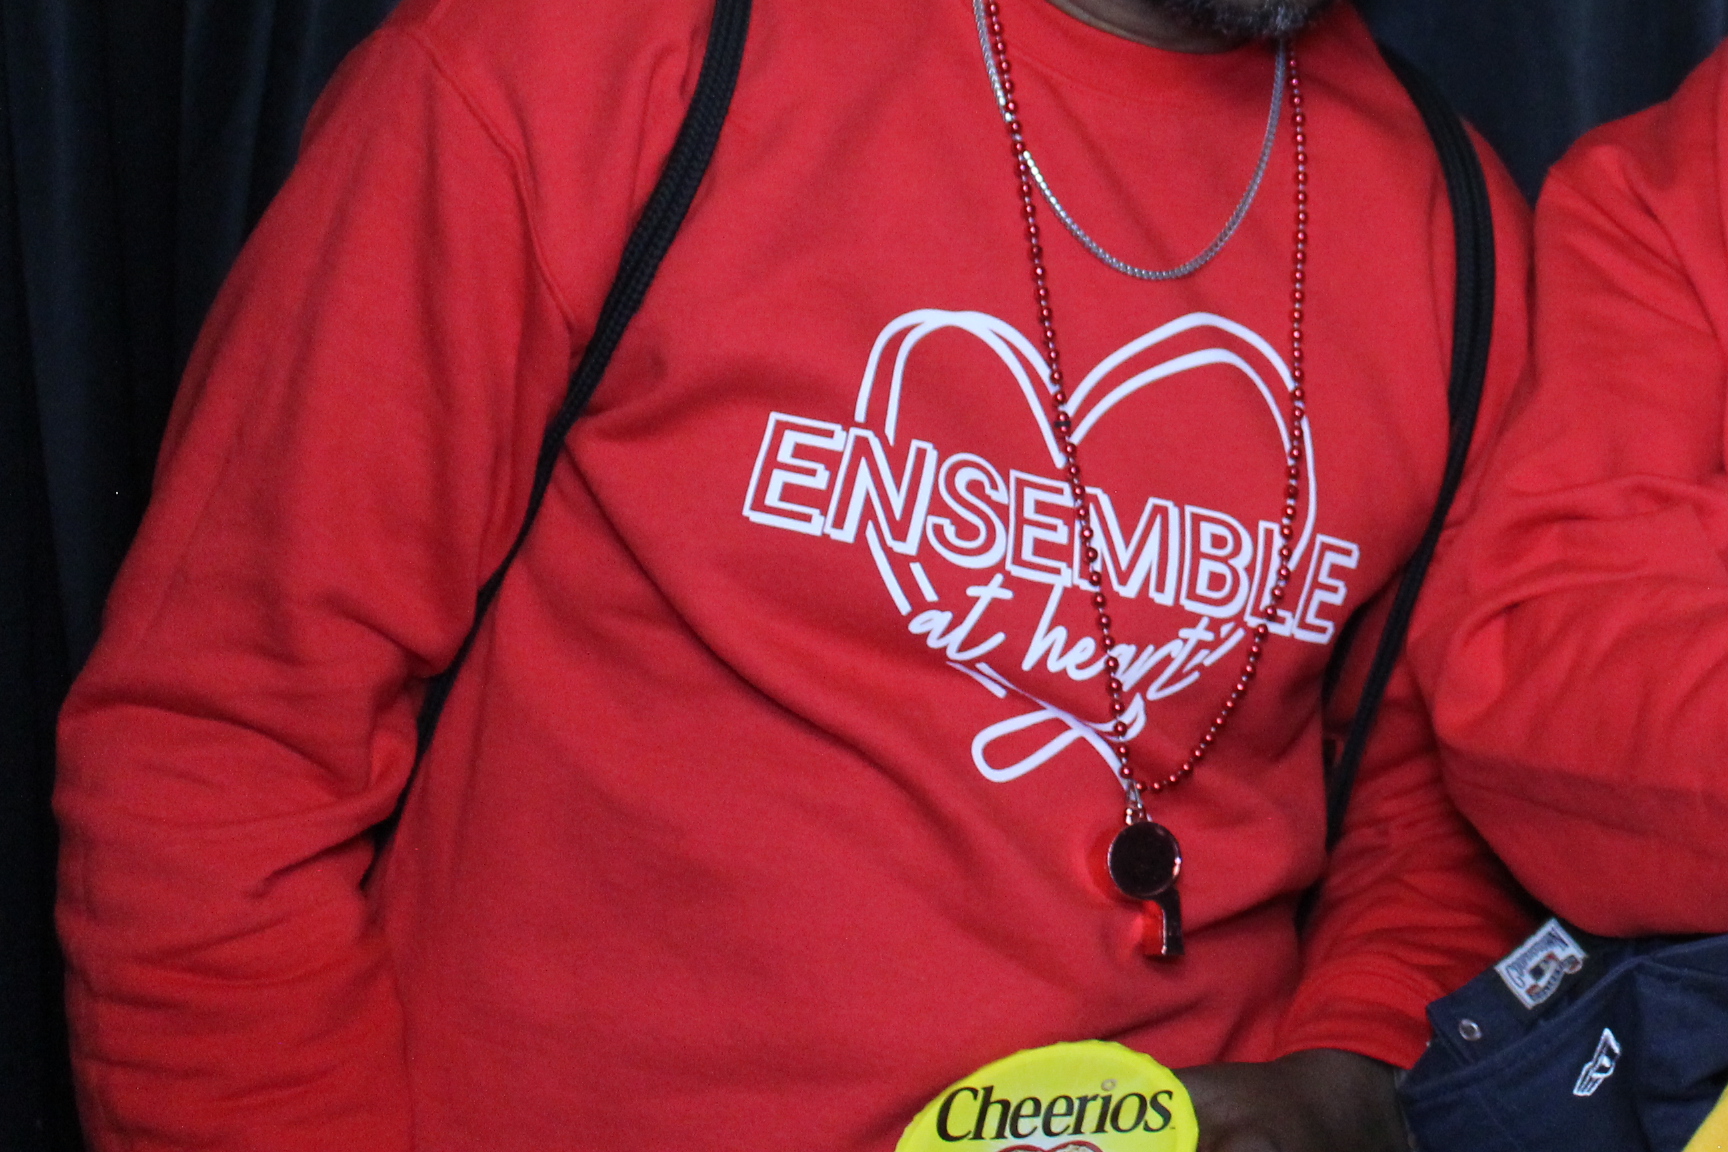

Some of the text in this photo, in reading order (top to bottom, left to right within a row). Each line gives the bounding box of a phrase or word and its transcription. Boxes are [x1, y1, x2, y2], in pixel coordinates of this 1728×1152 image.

[743, 412, 1360, 645] ENSEMBLE
[908, 572, 1214, 701] at heart
[936, 1078, 1174, 1142] Cheerios
